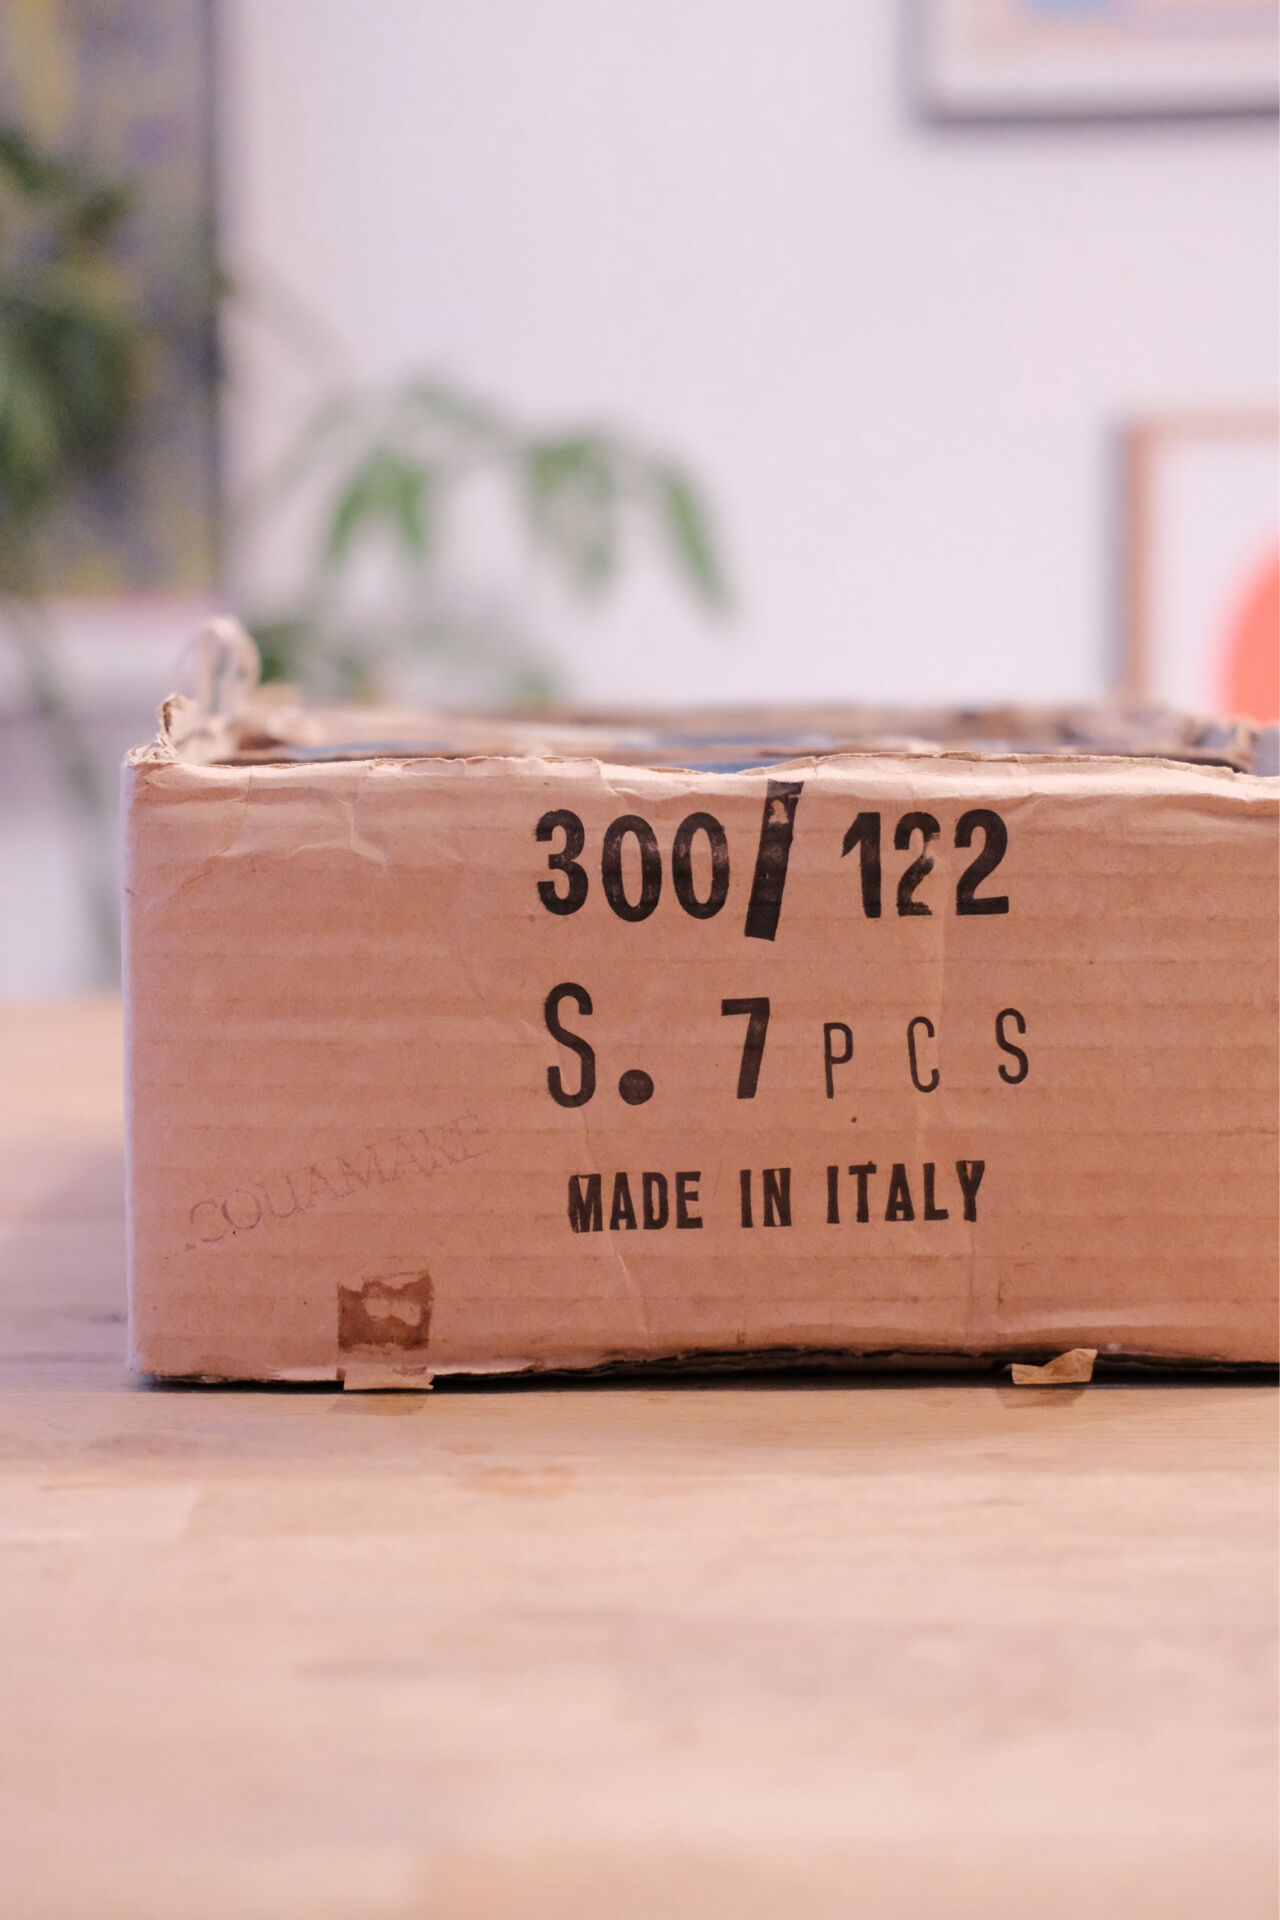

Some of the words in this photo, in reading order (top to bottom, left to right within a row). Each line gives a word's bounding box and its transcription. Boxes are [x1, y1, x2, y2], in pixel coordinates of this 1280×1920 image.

[840, 808, 1010, 919] 122
[543, 981, 656, 1109] S.
[720, 996, 771, 1100] 7
[567, 1170, 705, 1234] MADE
[739, 1167, 793, 1229] IN
[826, 1159, 986, 1225] ITALY
